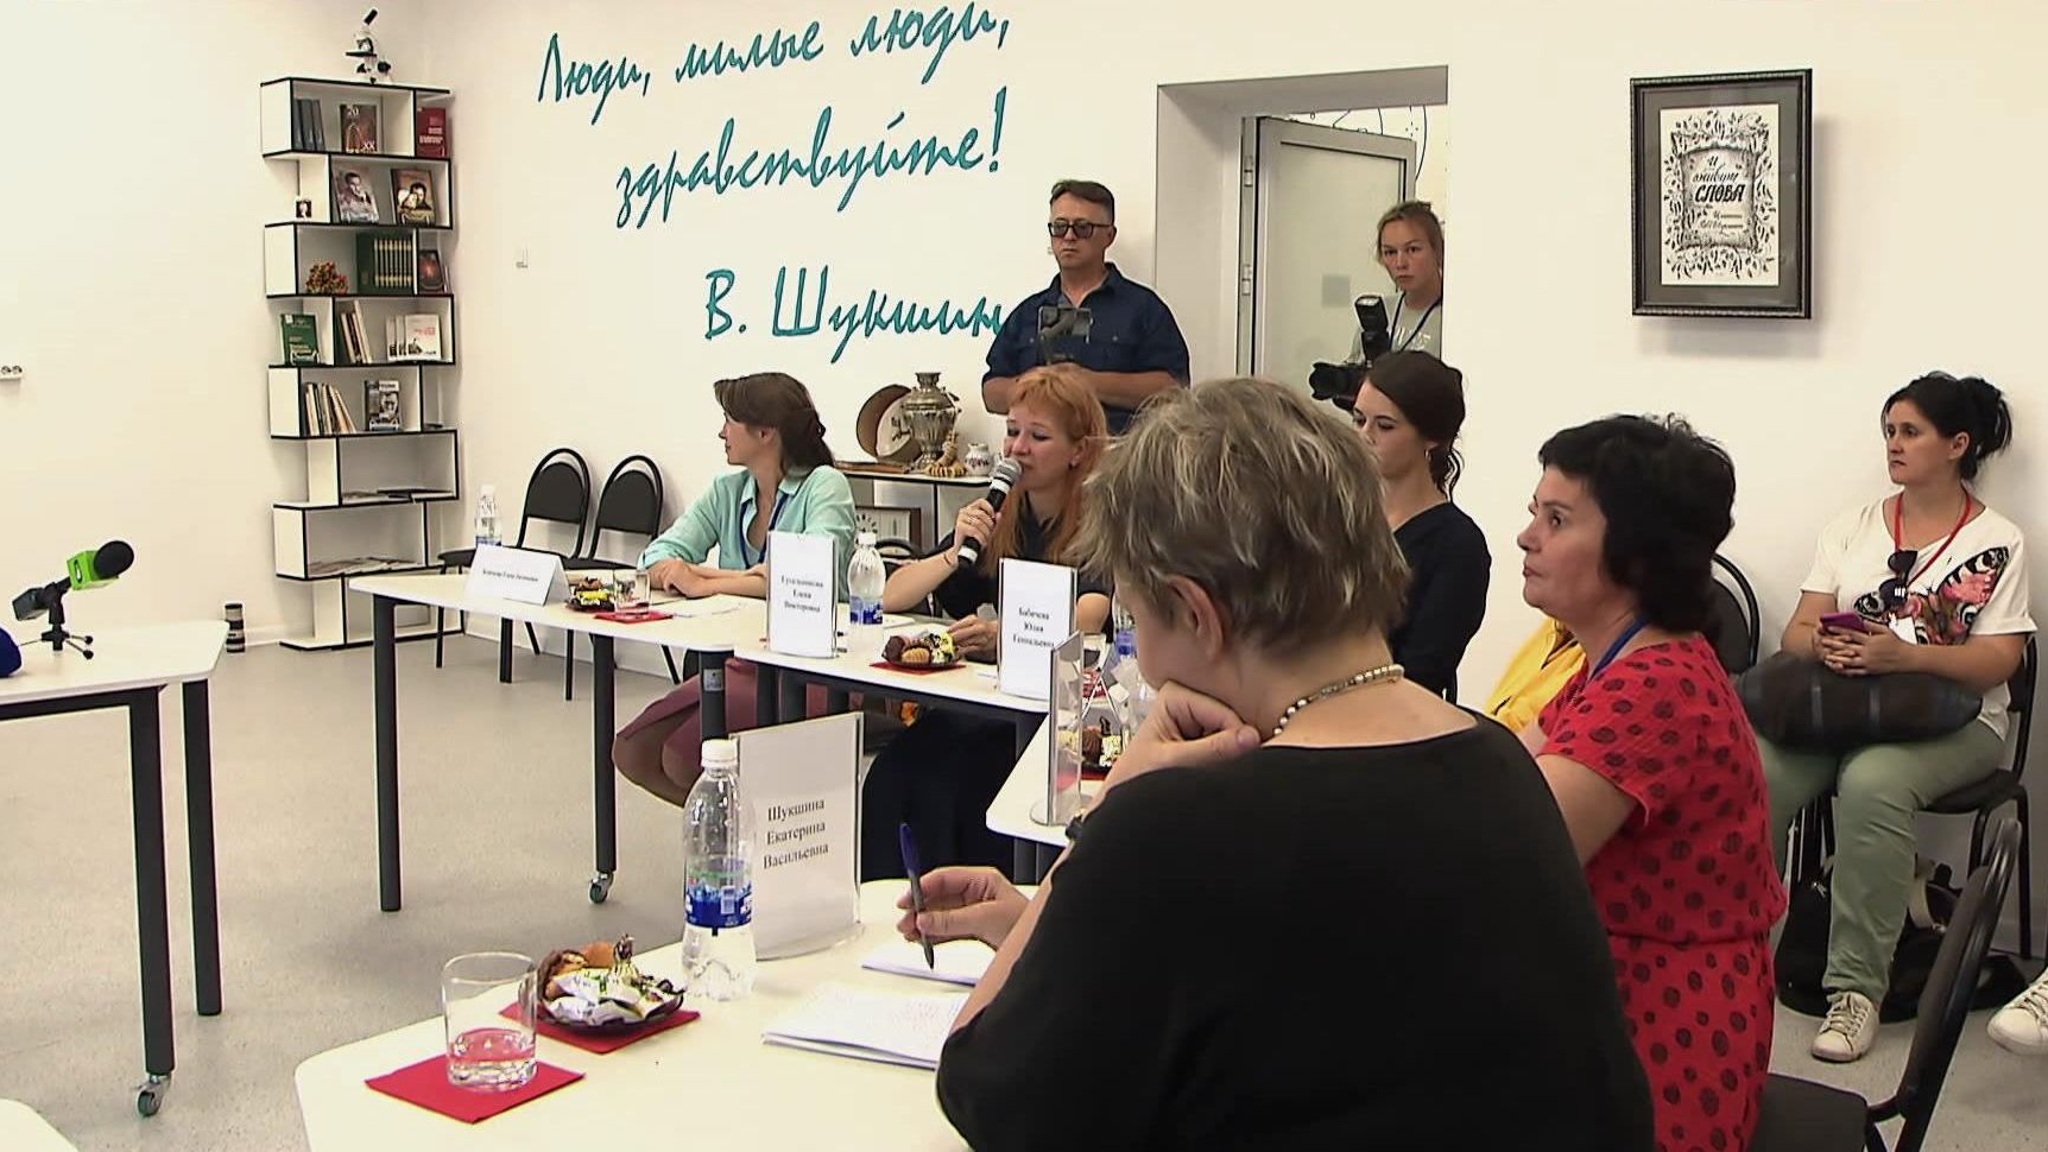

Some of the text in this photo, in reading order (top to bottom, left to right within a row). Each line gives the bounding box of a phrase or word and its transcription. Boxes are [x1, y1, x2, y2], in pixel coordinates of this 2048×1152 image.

[538, 1, 1010, 125] Люди, милые люди,
[616, 86, 1007, 229] здравствуйте!
[1695, 184, 1745, 202] СЛОВА
[704, 267, 747, 340] В.
[767, 799, 825, 822] Шукшина
[766, 822, 826, 845] Екатерина
[763, 844, 829, 869] Васильевна
